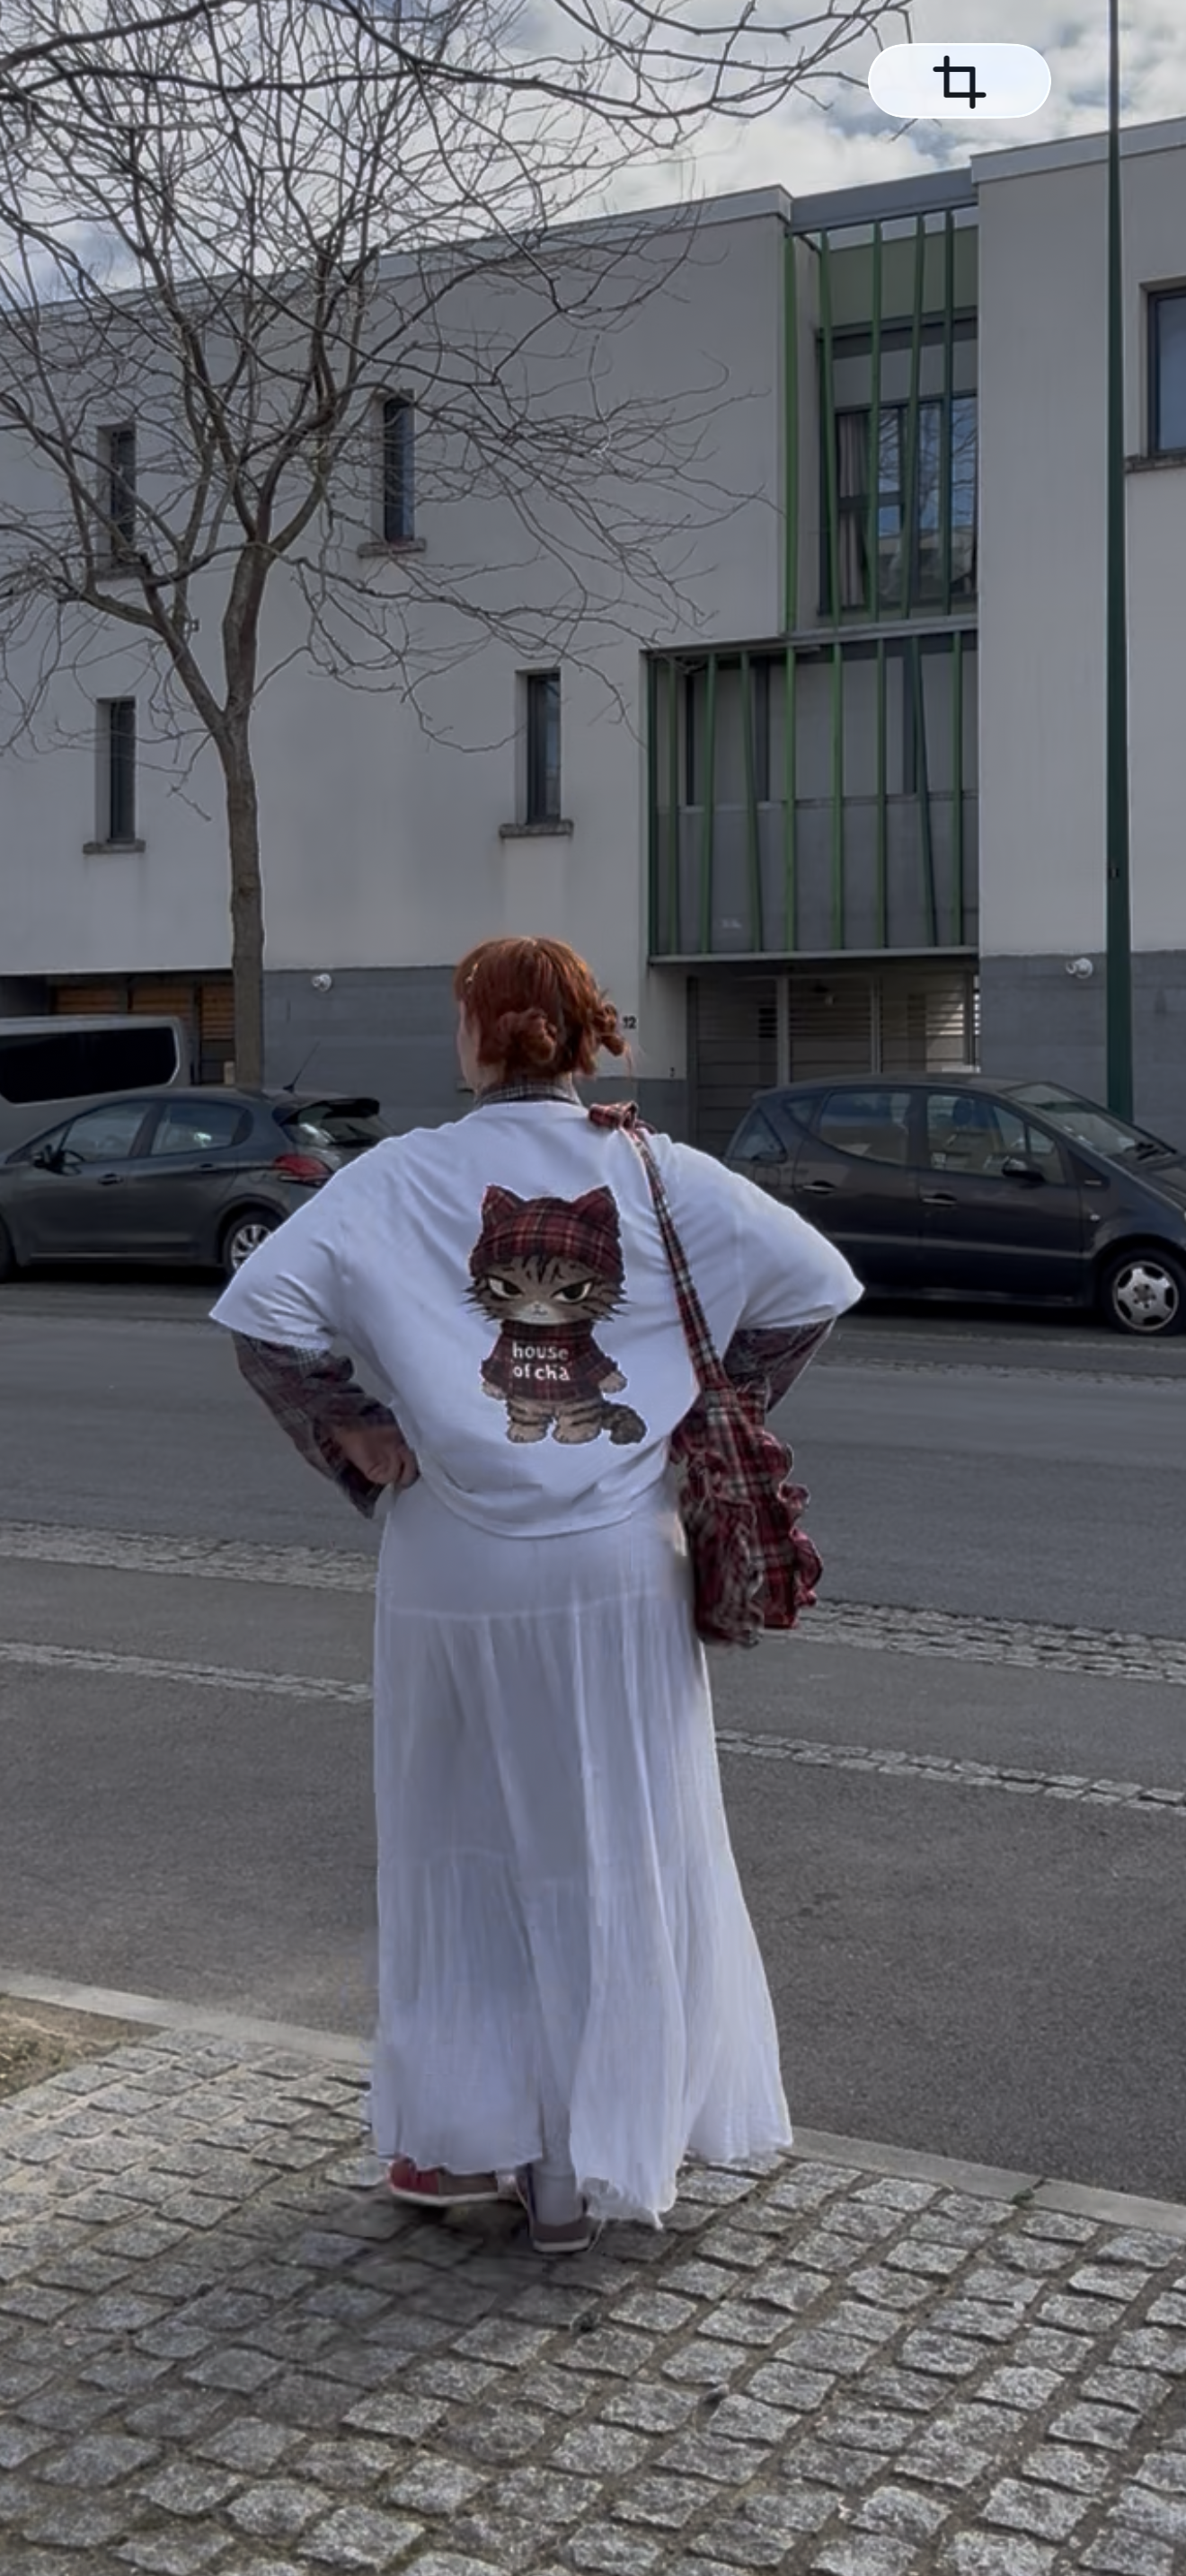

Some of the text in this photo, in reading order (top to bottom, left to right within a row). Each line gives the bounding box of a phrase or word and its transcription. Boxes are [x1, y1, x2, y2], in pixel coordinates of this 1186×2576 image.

[623, 1015, 637, 1030] 12
[512, 1341, 569, 1361] house
[512, 1363, 571, 1381] of cha
